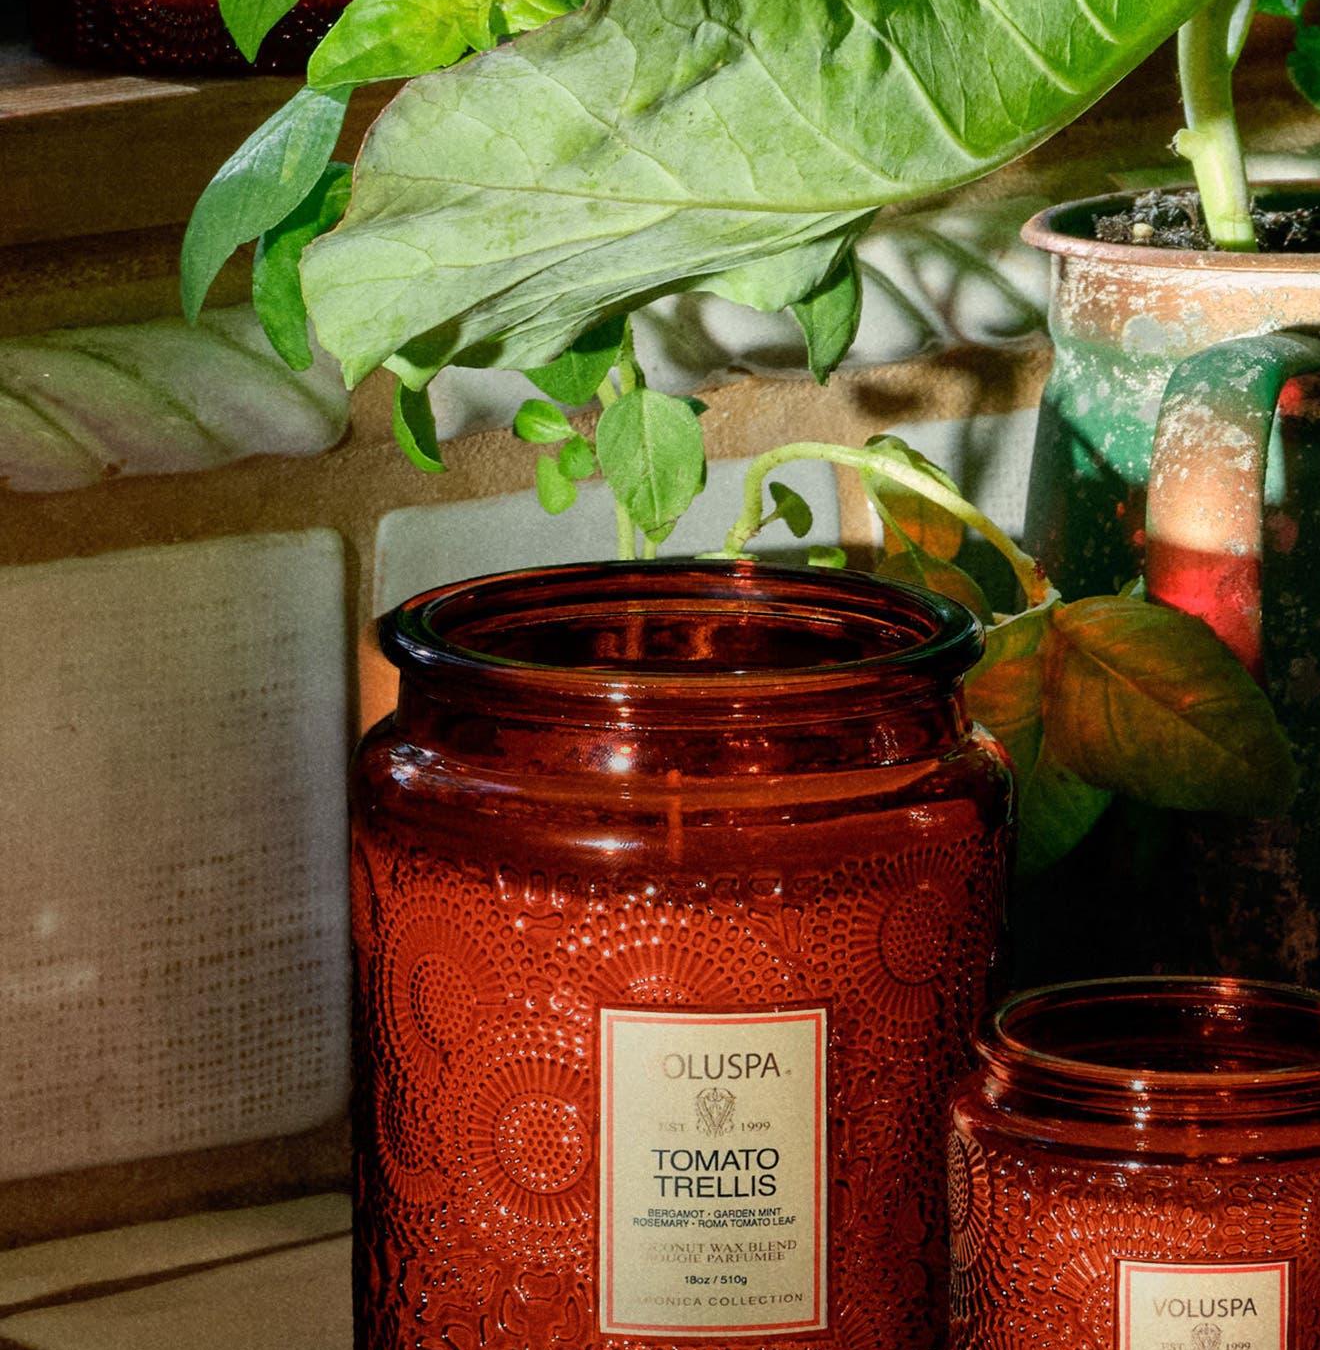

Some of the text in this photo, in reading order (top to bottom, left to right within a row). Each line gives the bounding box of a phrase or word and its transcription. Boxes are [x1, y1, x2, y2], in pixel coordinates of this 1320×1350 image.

[650, 1052, 781, 1080] OLUSPA
[741, 1121, 771, 1132] 1999
[651, 1148, 780, 1171] TOMATO
[653, 1174, 776, 1198] TRELLIS
[648, 1207, 782, 1219] BERGAMOT GARDEN MINT
[633, 1216, 796, 1228] ROSEMARY ROMA TOMATO LEAF
[710, 1242, 745, 1253] WAX
[748, 1239, 797, 1252] BLEND
[707, 1251, 786, 1263] PARFUMEE
[684, 1275, 710, 1285] 18oz
[720, 1275, 748, 1286] 510g
[708, 1293, 803, 1307] COLLECTION
[1153, 1298, 1257, 1318] VOLUSPA
